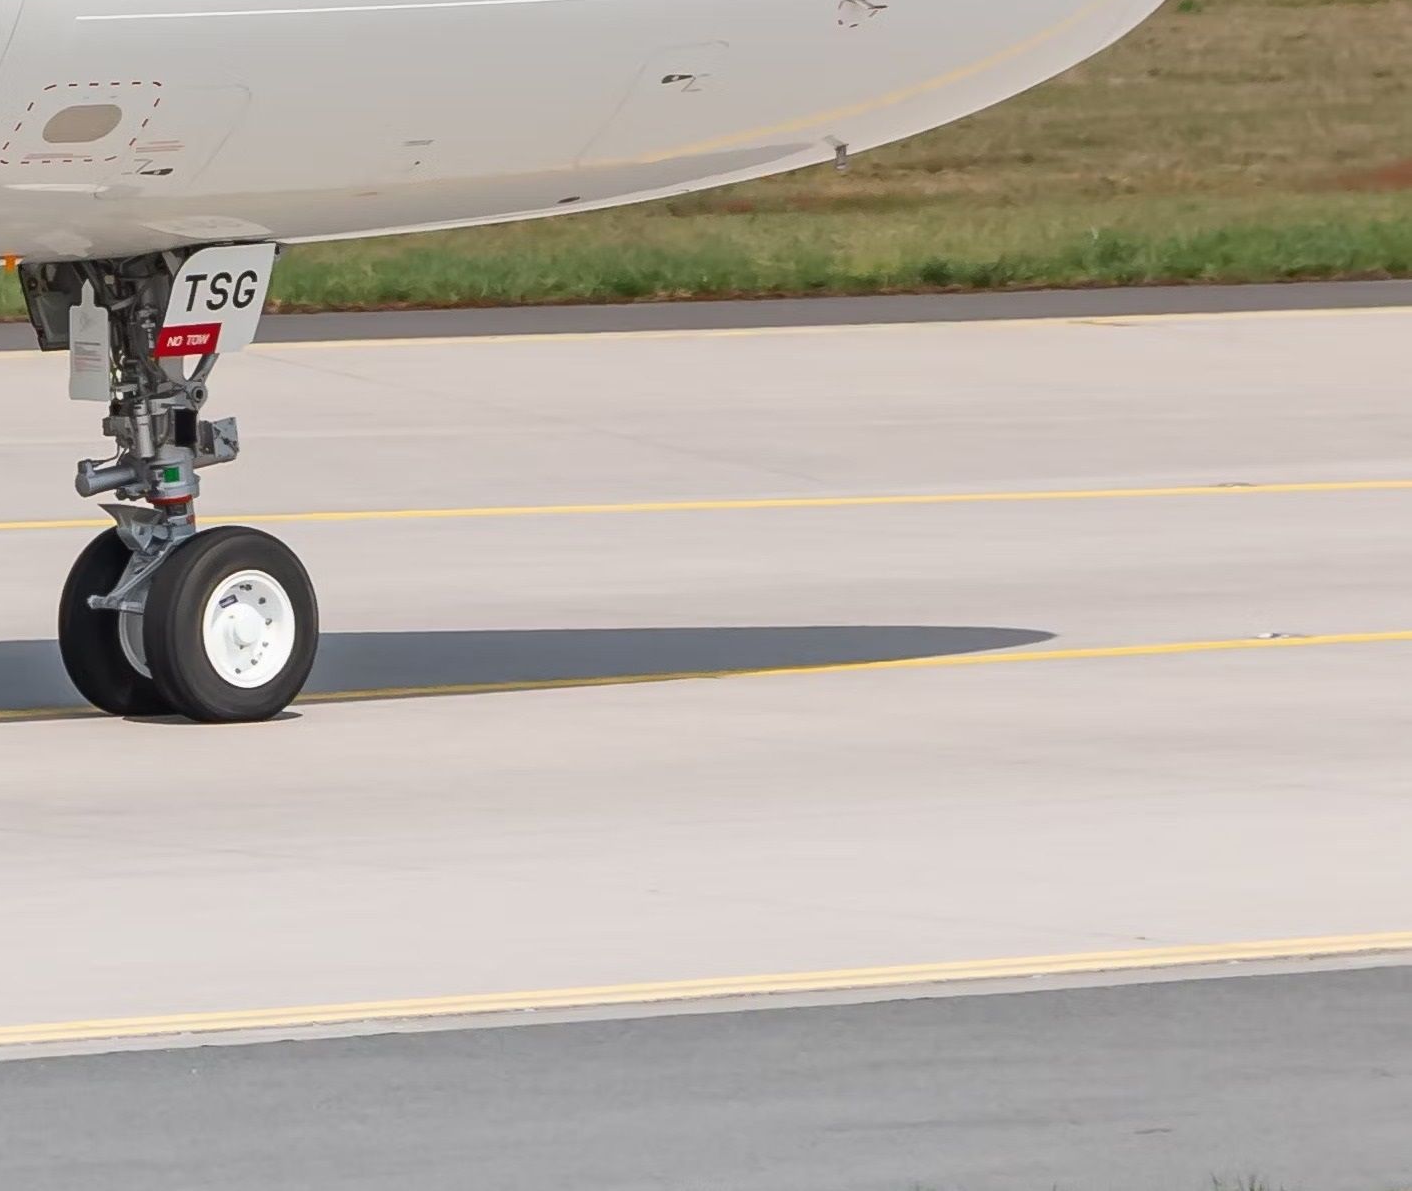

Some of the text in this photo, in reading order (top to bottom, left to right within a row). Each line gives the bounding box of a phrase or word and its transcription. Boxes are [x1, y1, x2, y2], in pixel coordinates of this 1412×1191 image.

[185, 270, 258, 312] TSG
[166, 333, 210, 347] NO TOW
